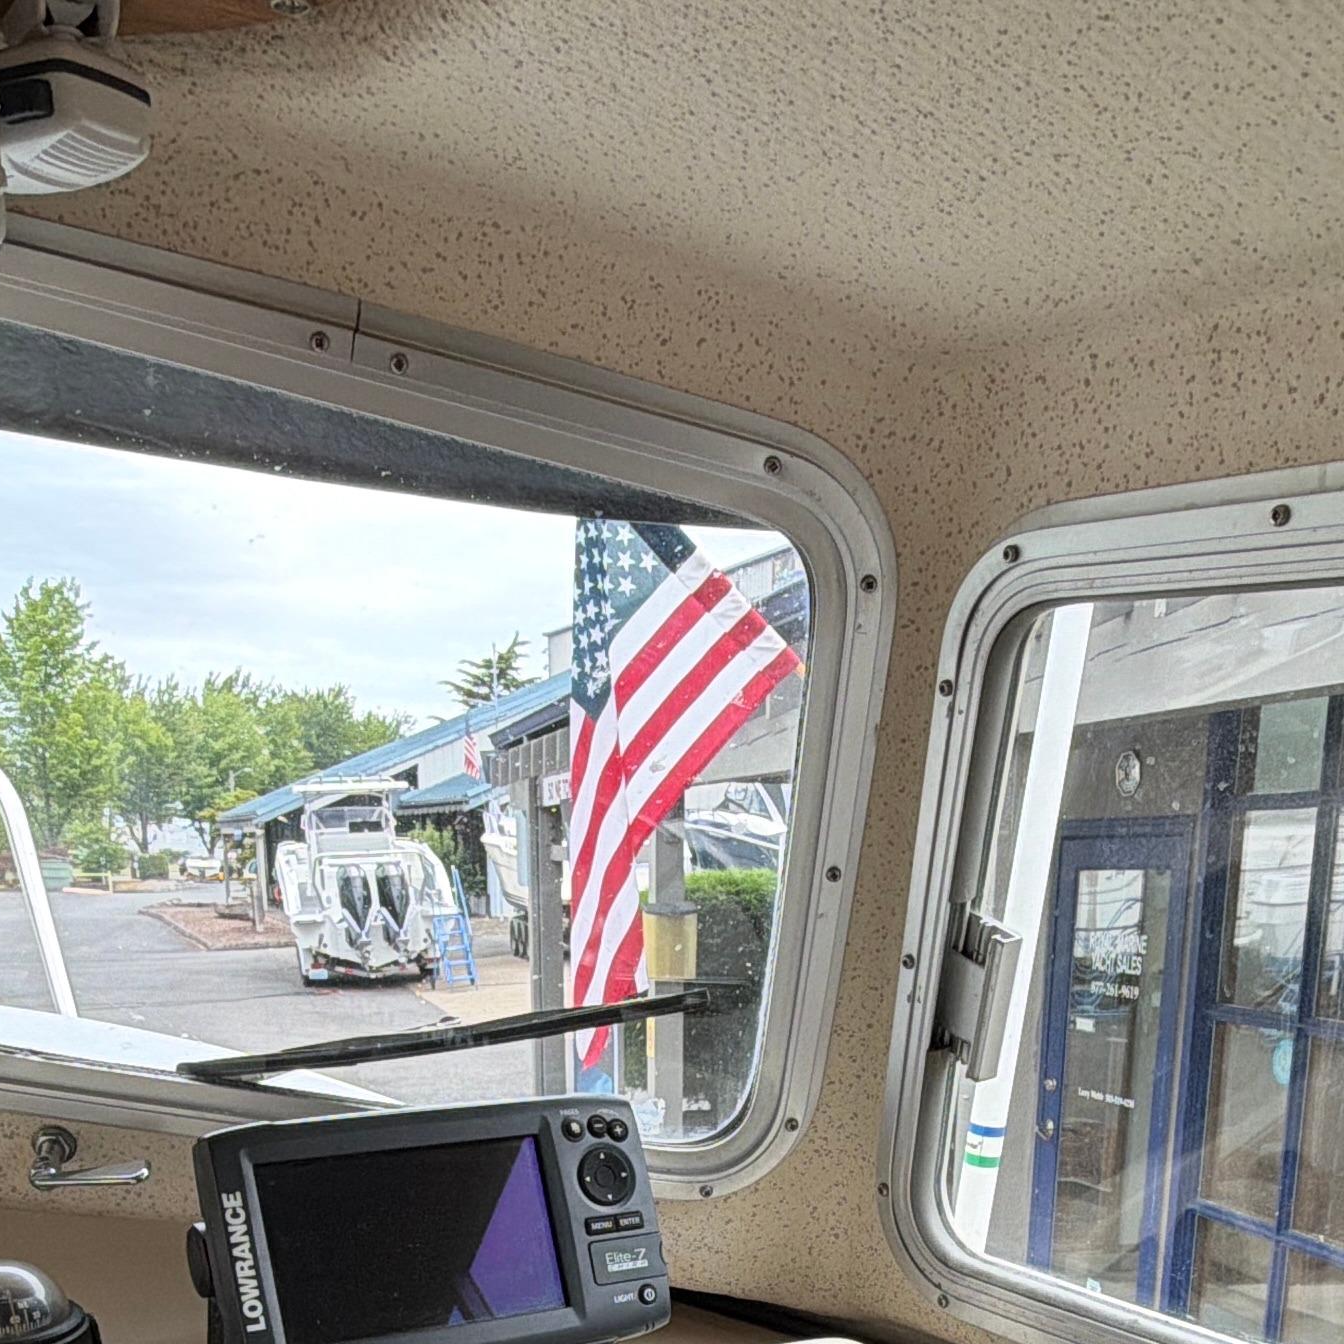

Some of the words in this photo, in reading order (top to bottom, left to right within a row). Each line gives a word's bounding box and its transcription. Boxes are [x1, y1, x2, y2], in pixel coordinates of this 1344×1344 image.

[1091, 952, 1116, 974] YACHT
[1116, 954, 1143, 976] SALES
[591, 1220, 613, 1231] MENU
[619, 1216, 641, 1227] ENTER
[221, 1190, 268, 1334] LOWRANCE
[605, 1247, 647, 1265] Elite-7
[614, 1290, 635, 1304] LIGHT
